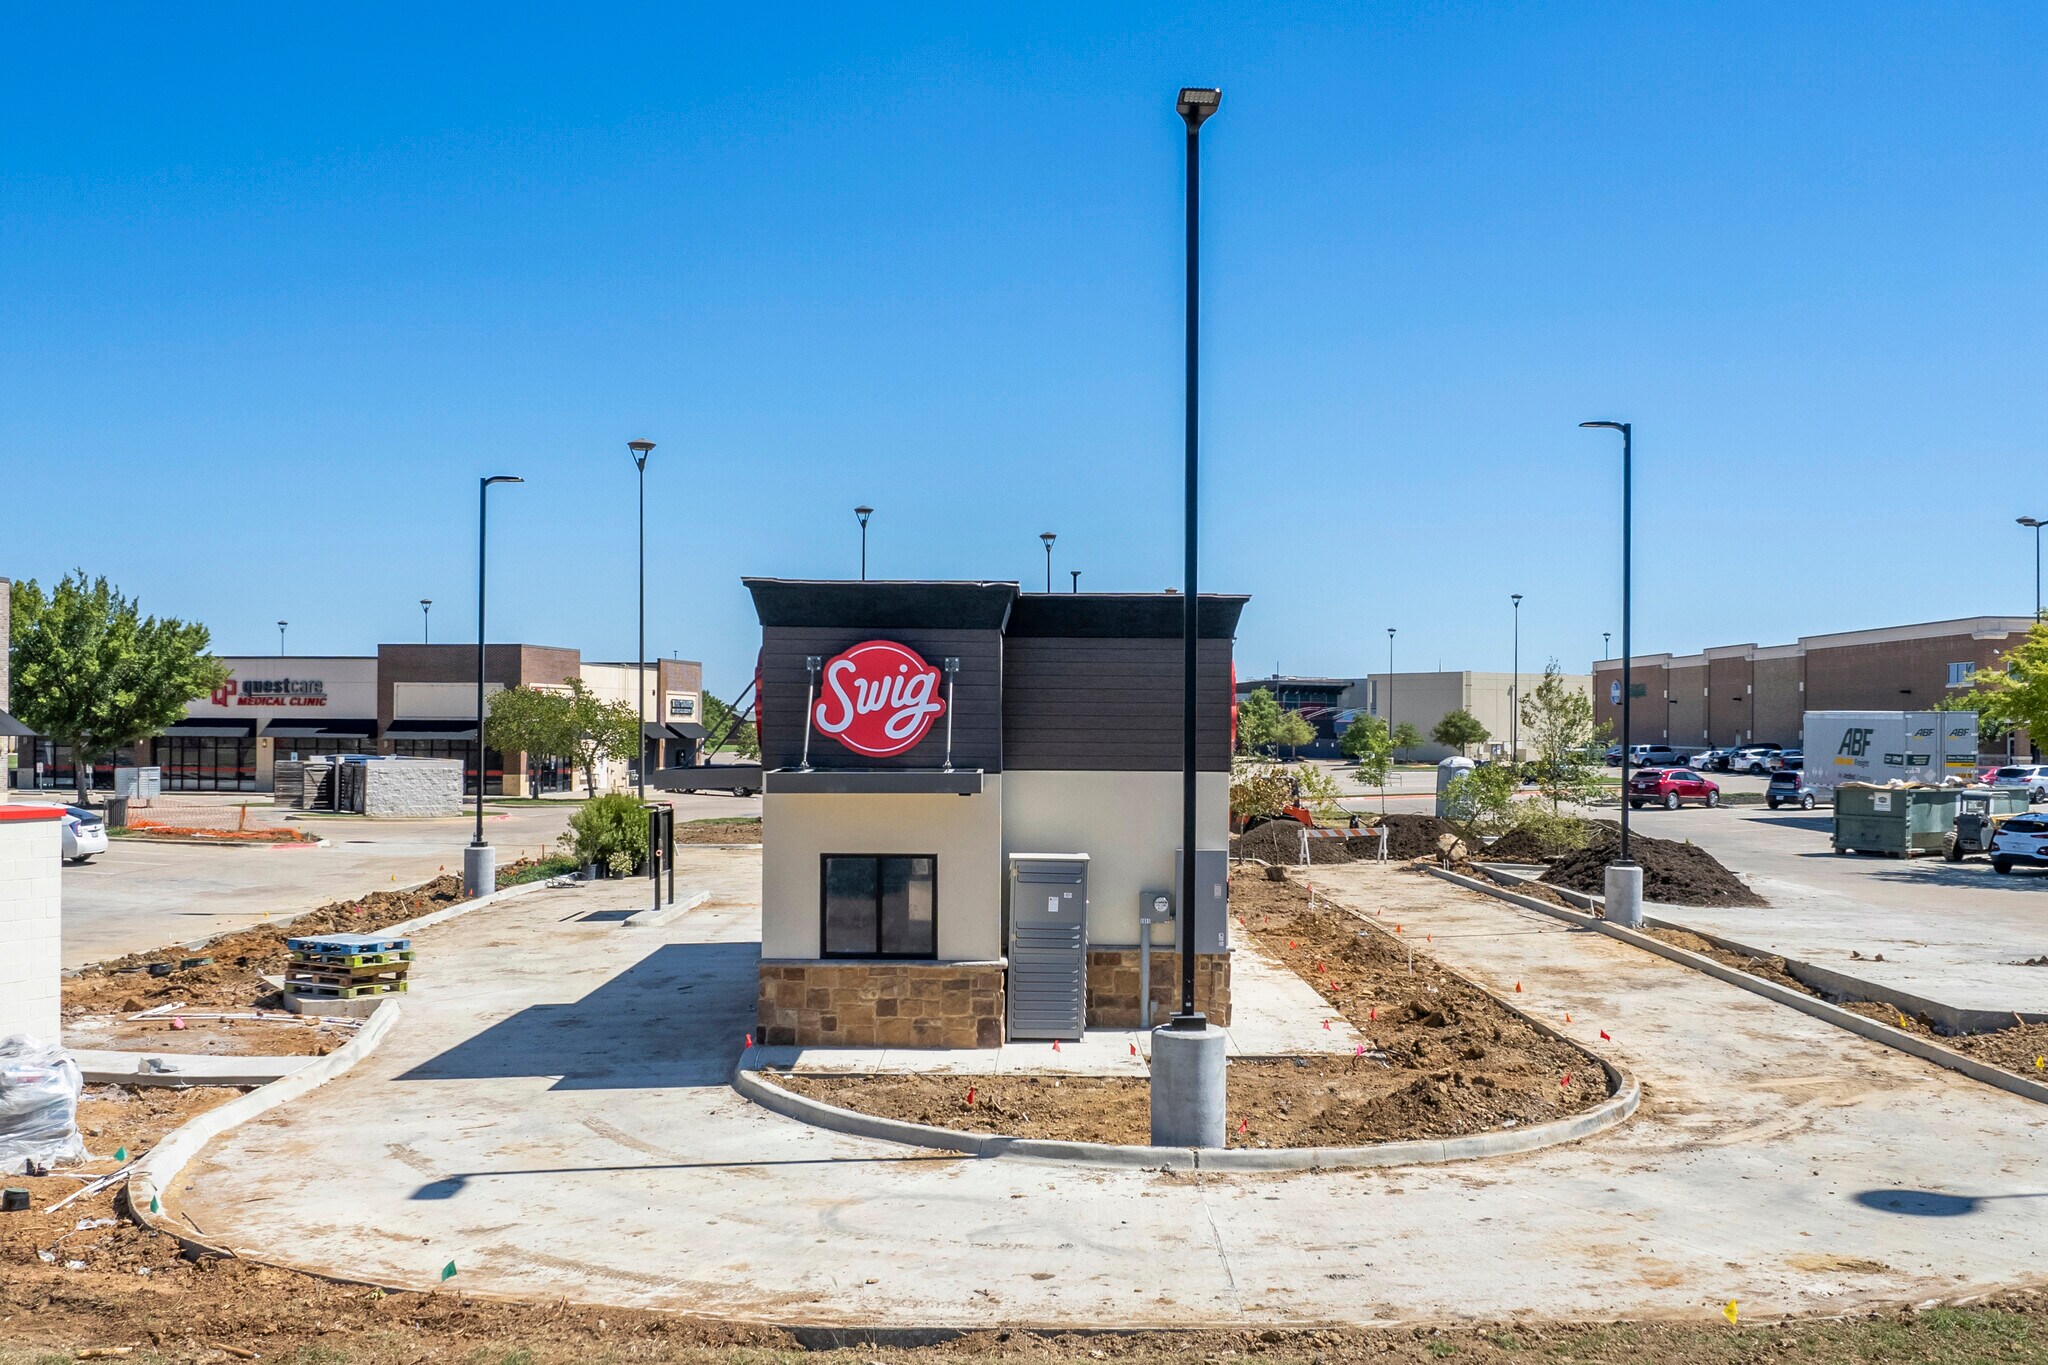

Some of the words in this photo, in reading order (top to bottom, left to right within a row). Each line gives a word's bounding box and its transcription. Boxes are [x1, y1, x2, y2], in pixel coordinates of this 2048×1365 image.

[242, 678, 323, 697] questcare
[237, 697, 286, 706] MEDICAL
[289, 697, 327, 706] CLINIC
[816, 660, 940, 739] Swig
[1914, 728, 1935, 736] ABF
[1949, 728, 1969, 736] ABF
[1837, 728, 1874, 756] ABF
